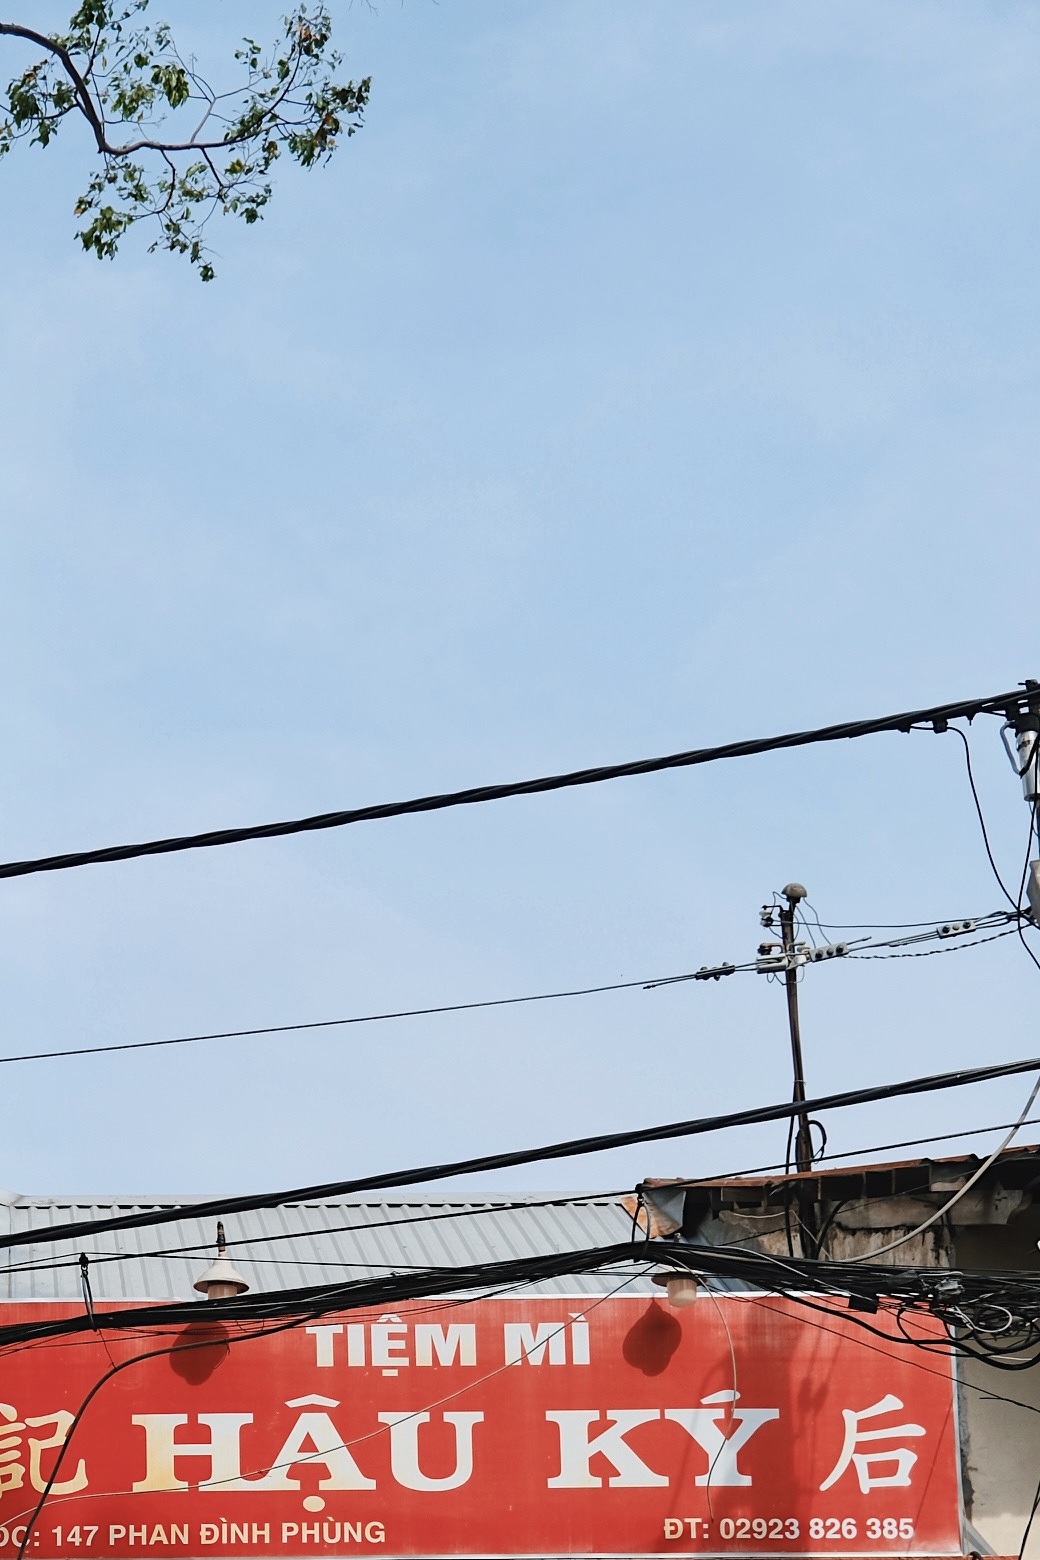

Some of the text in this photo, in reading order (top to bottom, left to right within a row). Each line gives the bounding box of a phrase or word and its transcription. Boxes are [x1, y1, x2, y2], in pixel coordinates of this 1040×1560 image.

[305, 1313, 591, 1377] TIỆM MÌ
[131, 1393, 484, 1513] HẬU
[545, 1389, 780, 1489] KÝ
[819, 1393, 927, 1495] 后
[52, 1525, 99, 1548] 147
[109, 1523, 189, 1546] PHAN
[199, 1517, 271, 1545] ĐÌNH
[281, 1515, 386, 1544] PHÙNG
[663, 1517, 914, 1540] ĐT: 02923 826 385
